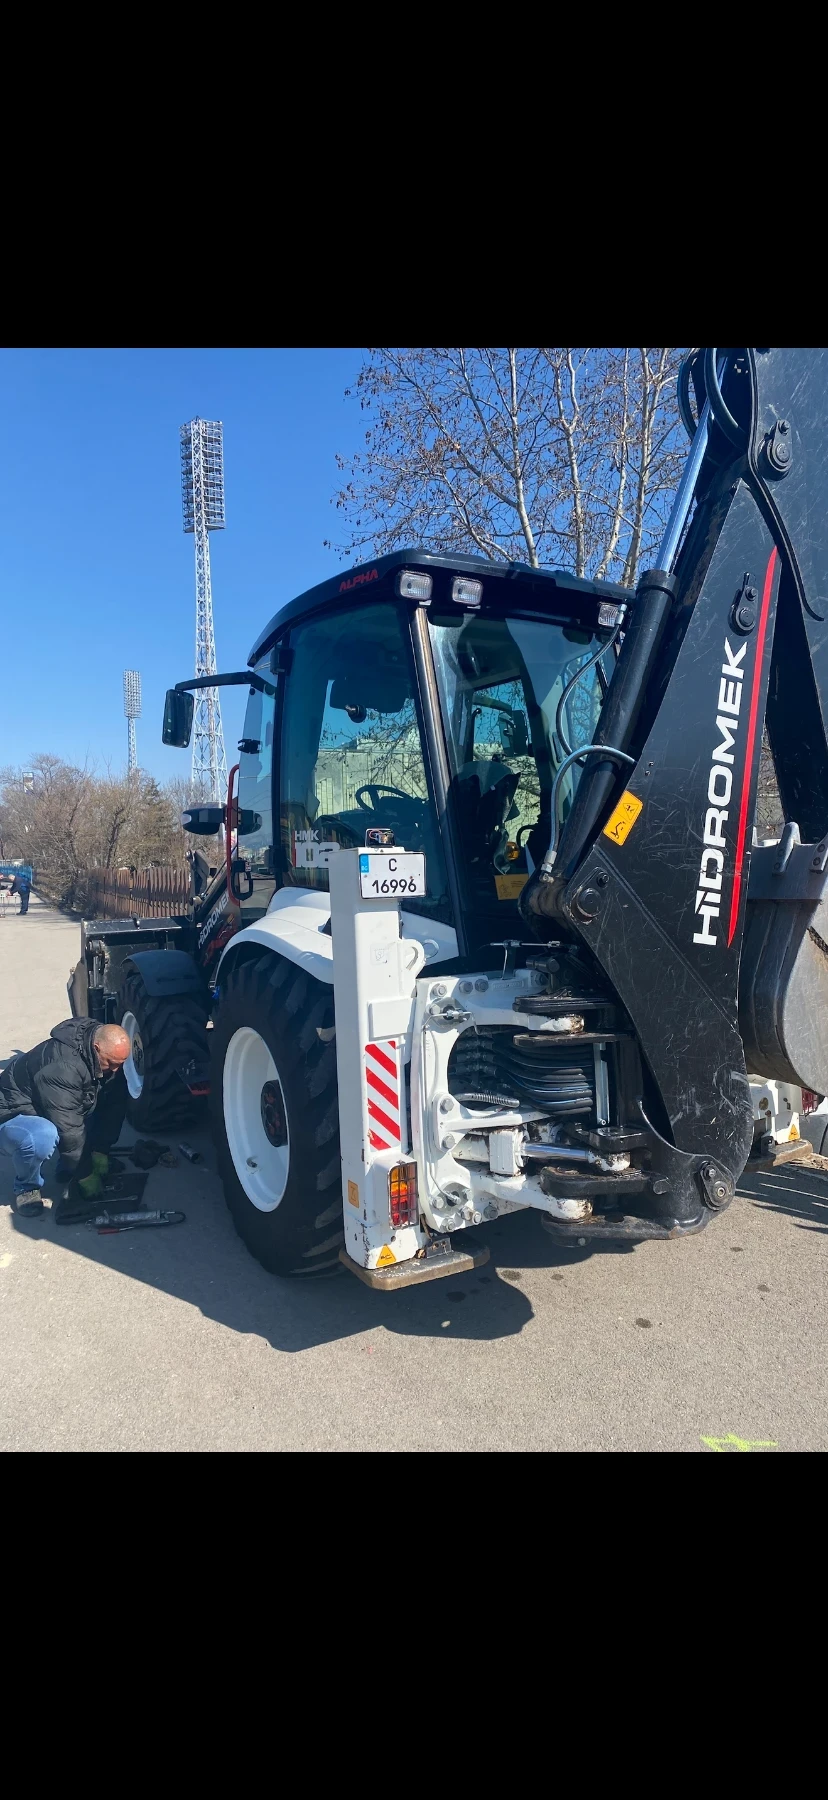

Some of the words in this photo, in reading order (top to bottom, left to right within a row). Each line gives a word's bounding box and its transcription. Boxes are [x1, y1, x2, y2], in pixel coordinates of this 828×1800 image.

[339, 568, 379, 592] ALPHA
[294, 829, 320, 841] HMK
[388, 858, 398, 872] C
[371, 878, 417, 894] 16996
